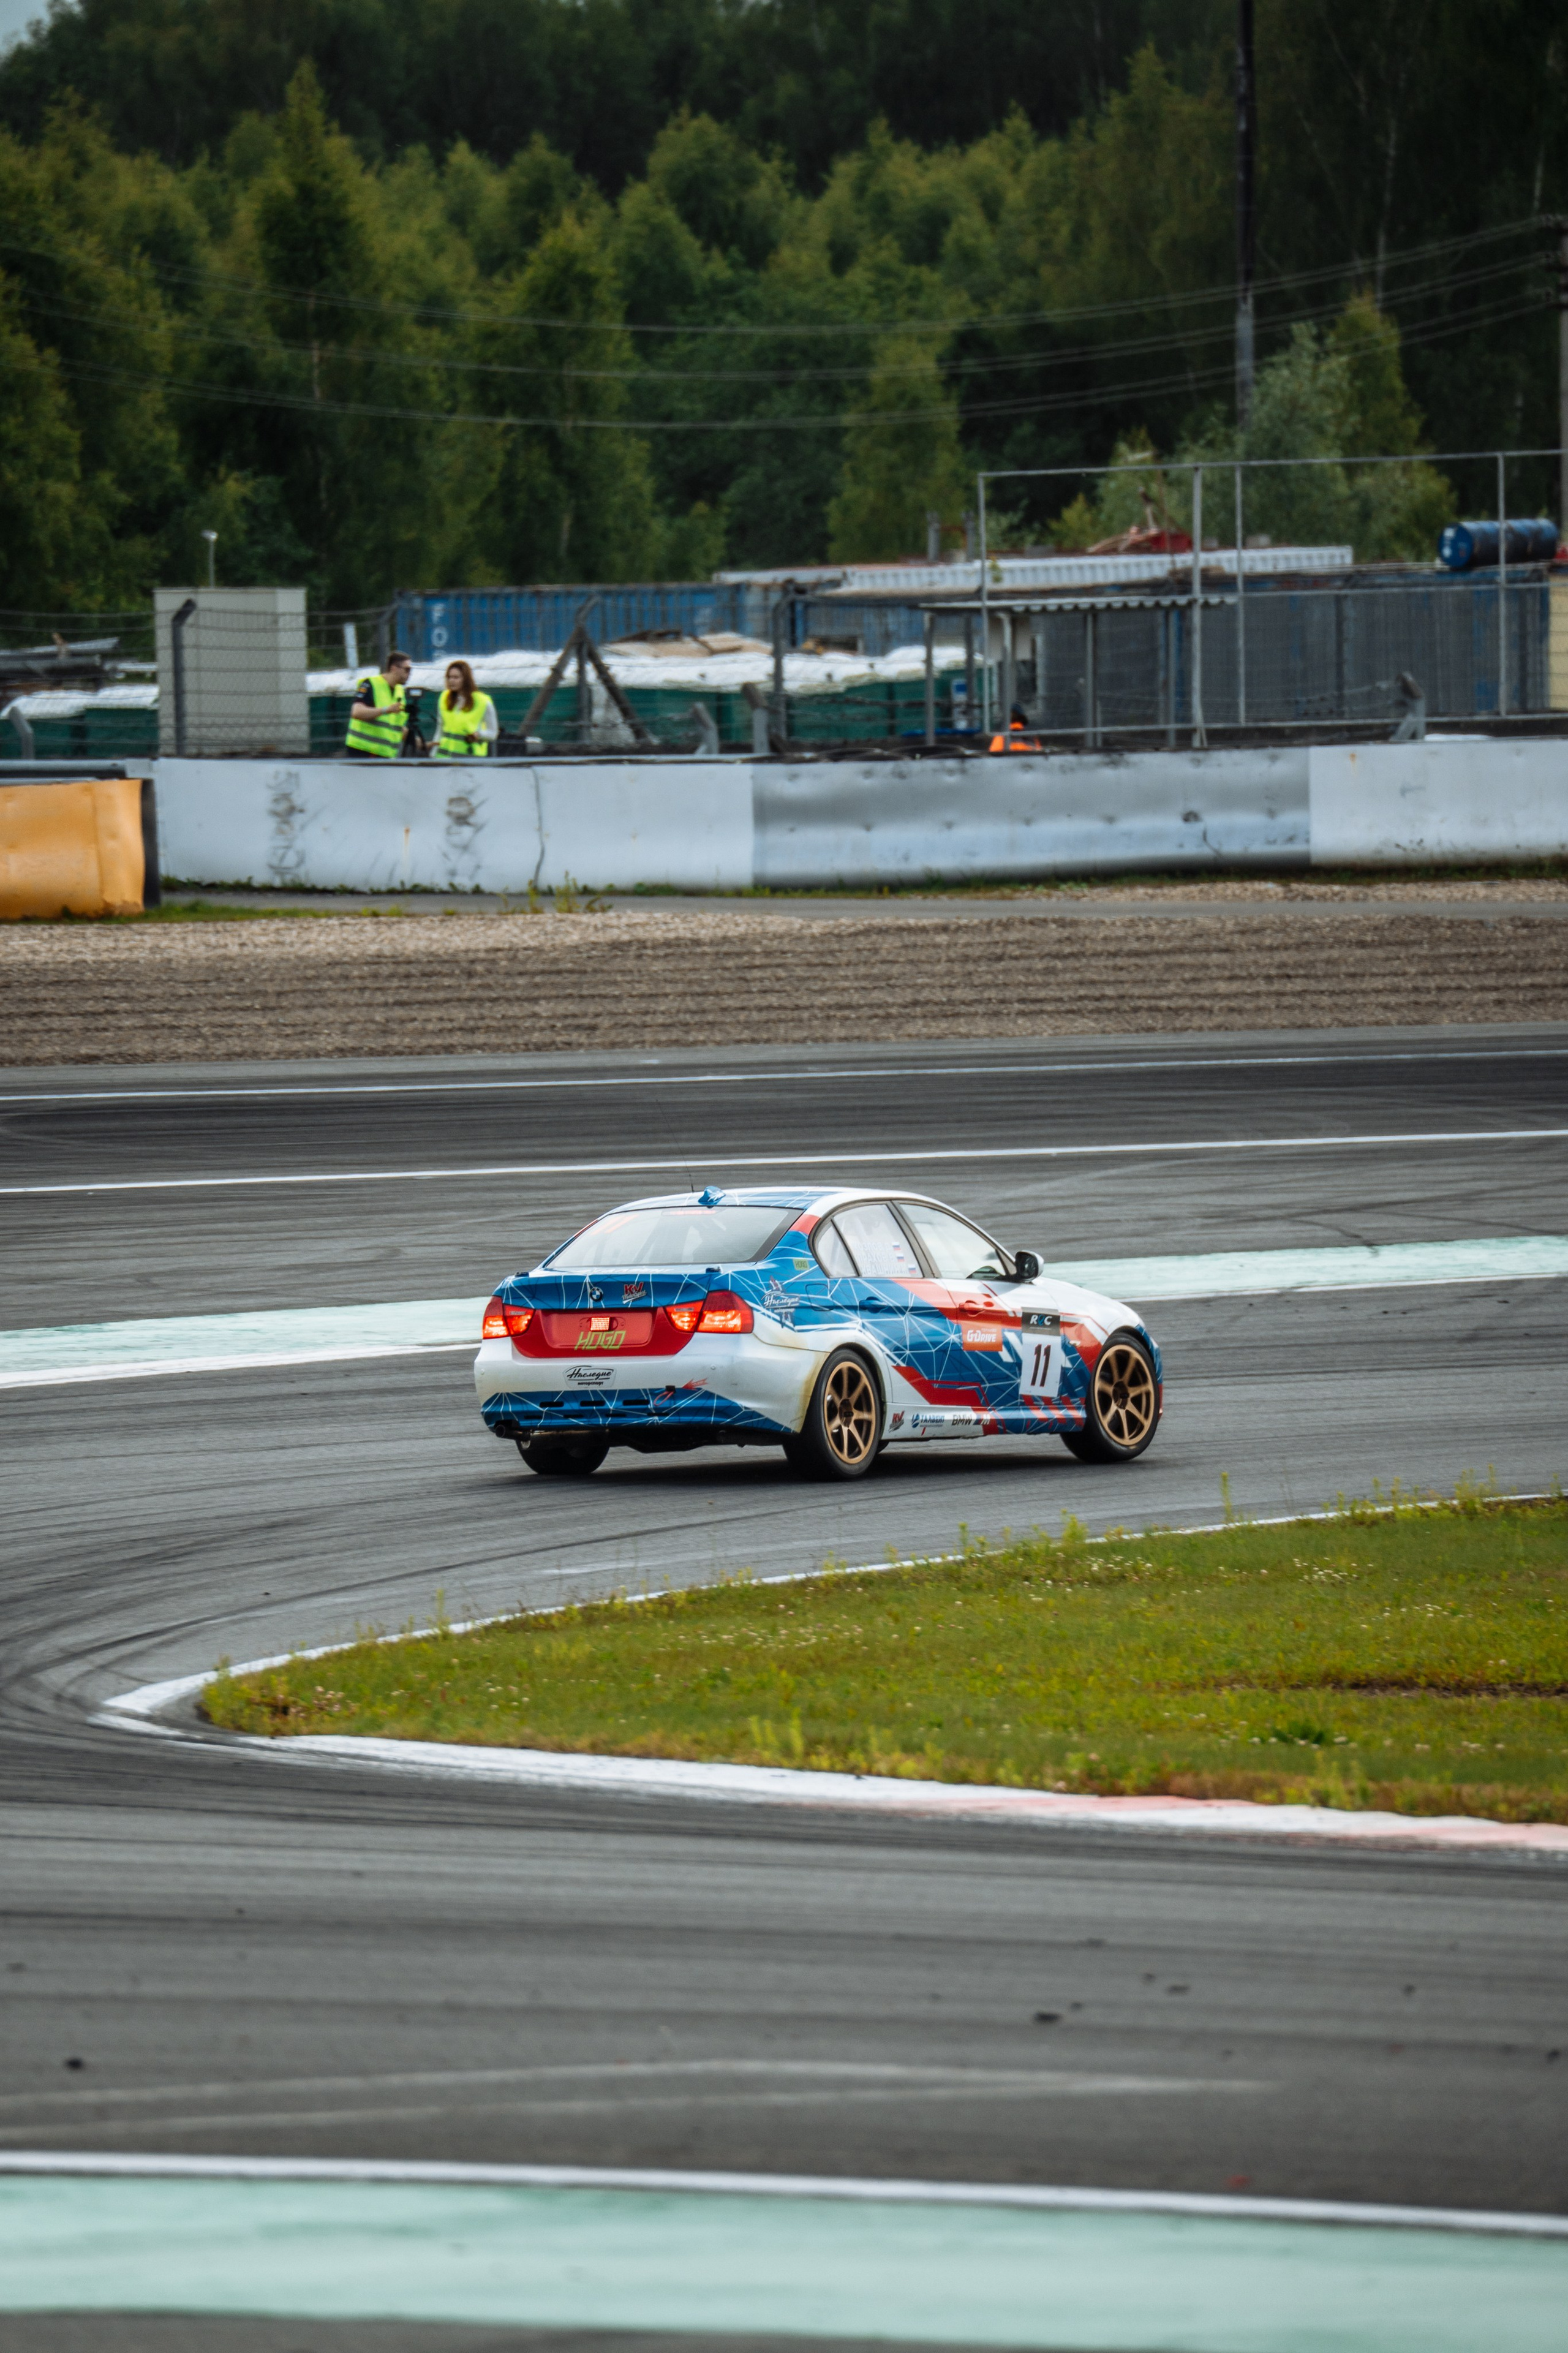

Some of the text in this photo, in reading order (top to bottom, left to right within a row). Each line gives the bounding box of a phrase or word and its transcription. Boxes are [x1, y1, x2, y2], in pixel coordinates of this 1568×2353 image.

[624, 1282, 644, 1295] KV
[574, 1331, 626, 1350] HOGO
[1030, 1343, 1051, 1387] 11
[567, 1367, 612, 1380] Наследие
[951, 1414, 973, 1426] BMW
